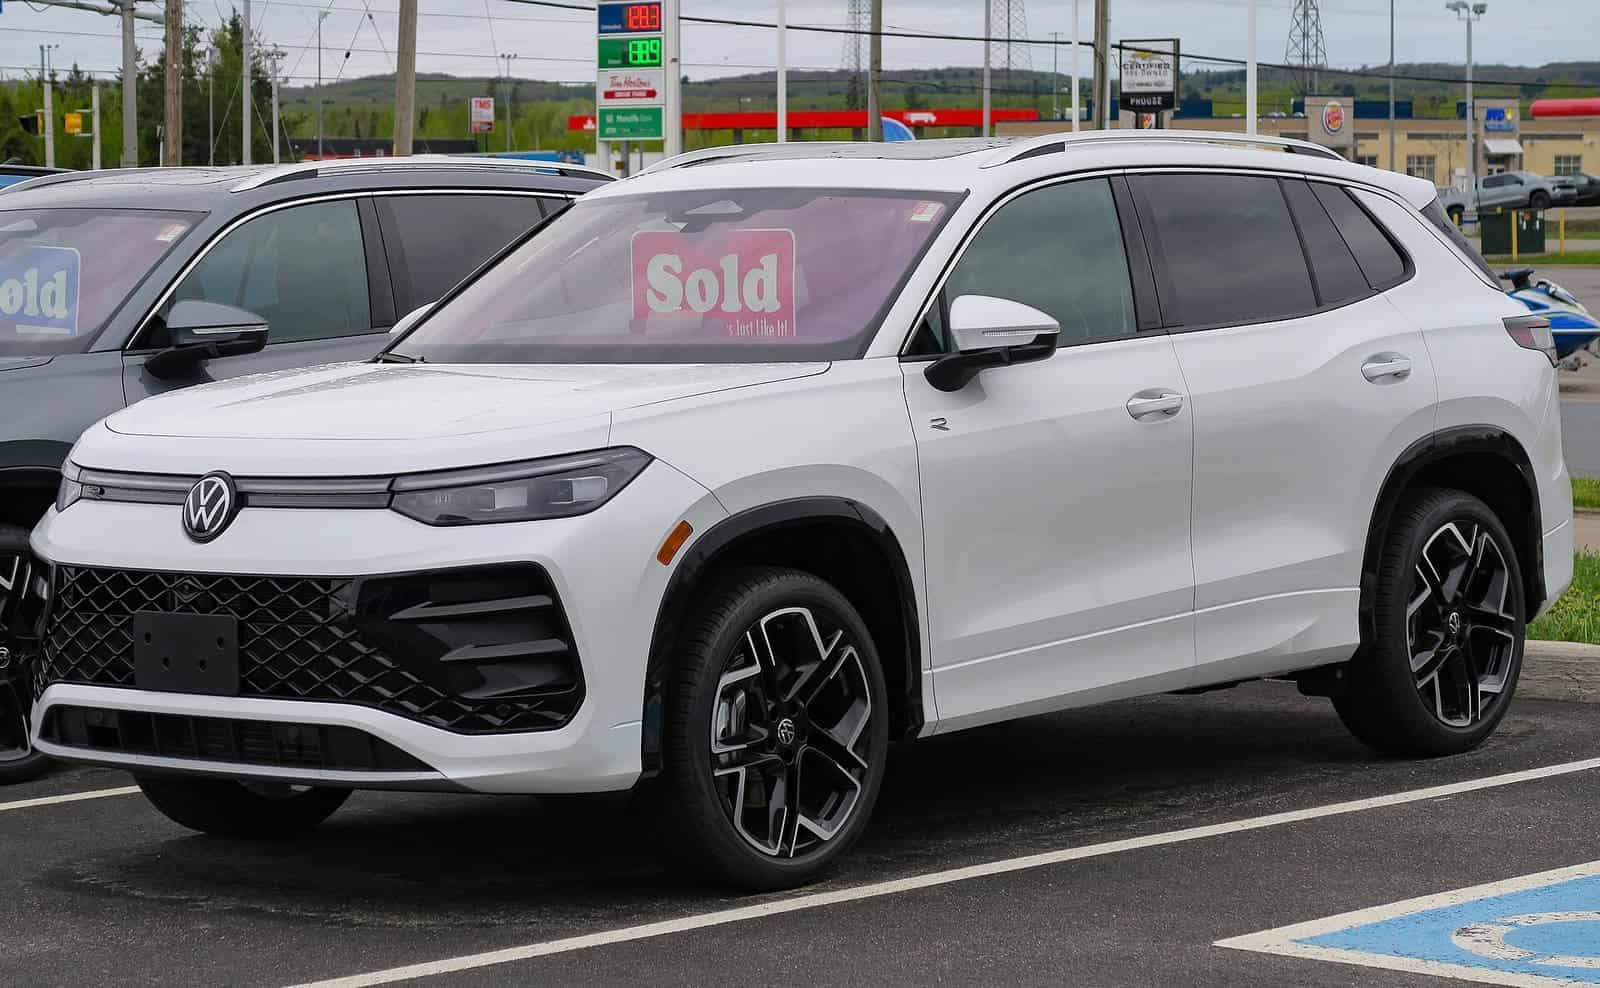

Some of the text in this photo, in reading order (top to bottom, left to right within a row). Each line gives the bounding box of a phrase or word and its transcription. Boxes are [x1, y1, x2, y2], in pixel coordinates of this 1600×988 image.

[0, 268, 69, 319] old
[646, 253, 782, 313] Sold
[186, 478, 229, 532] VW
